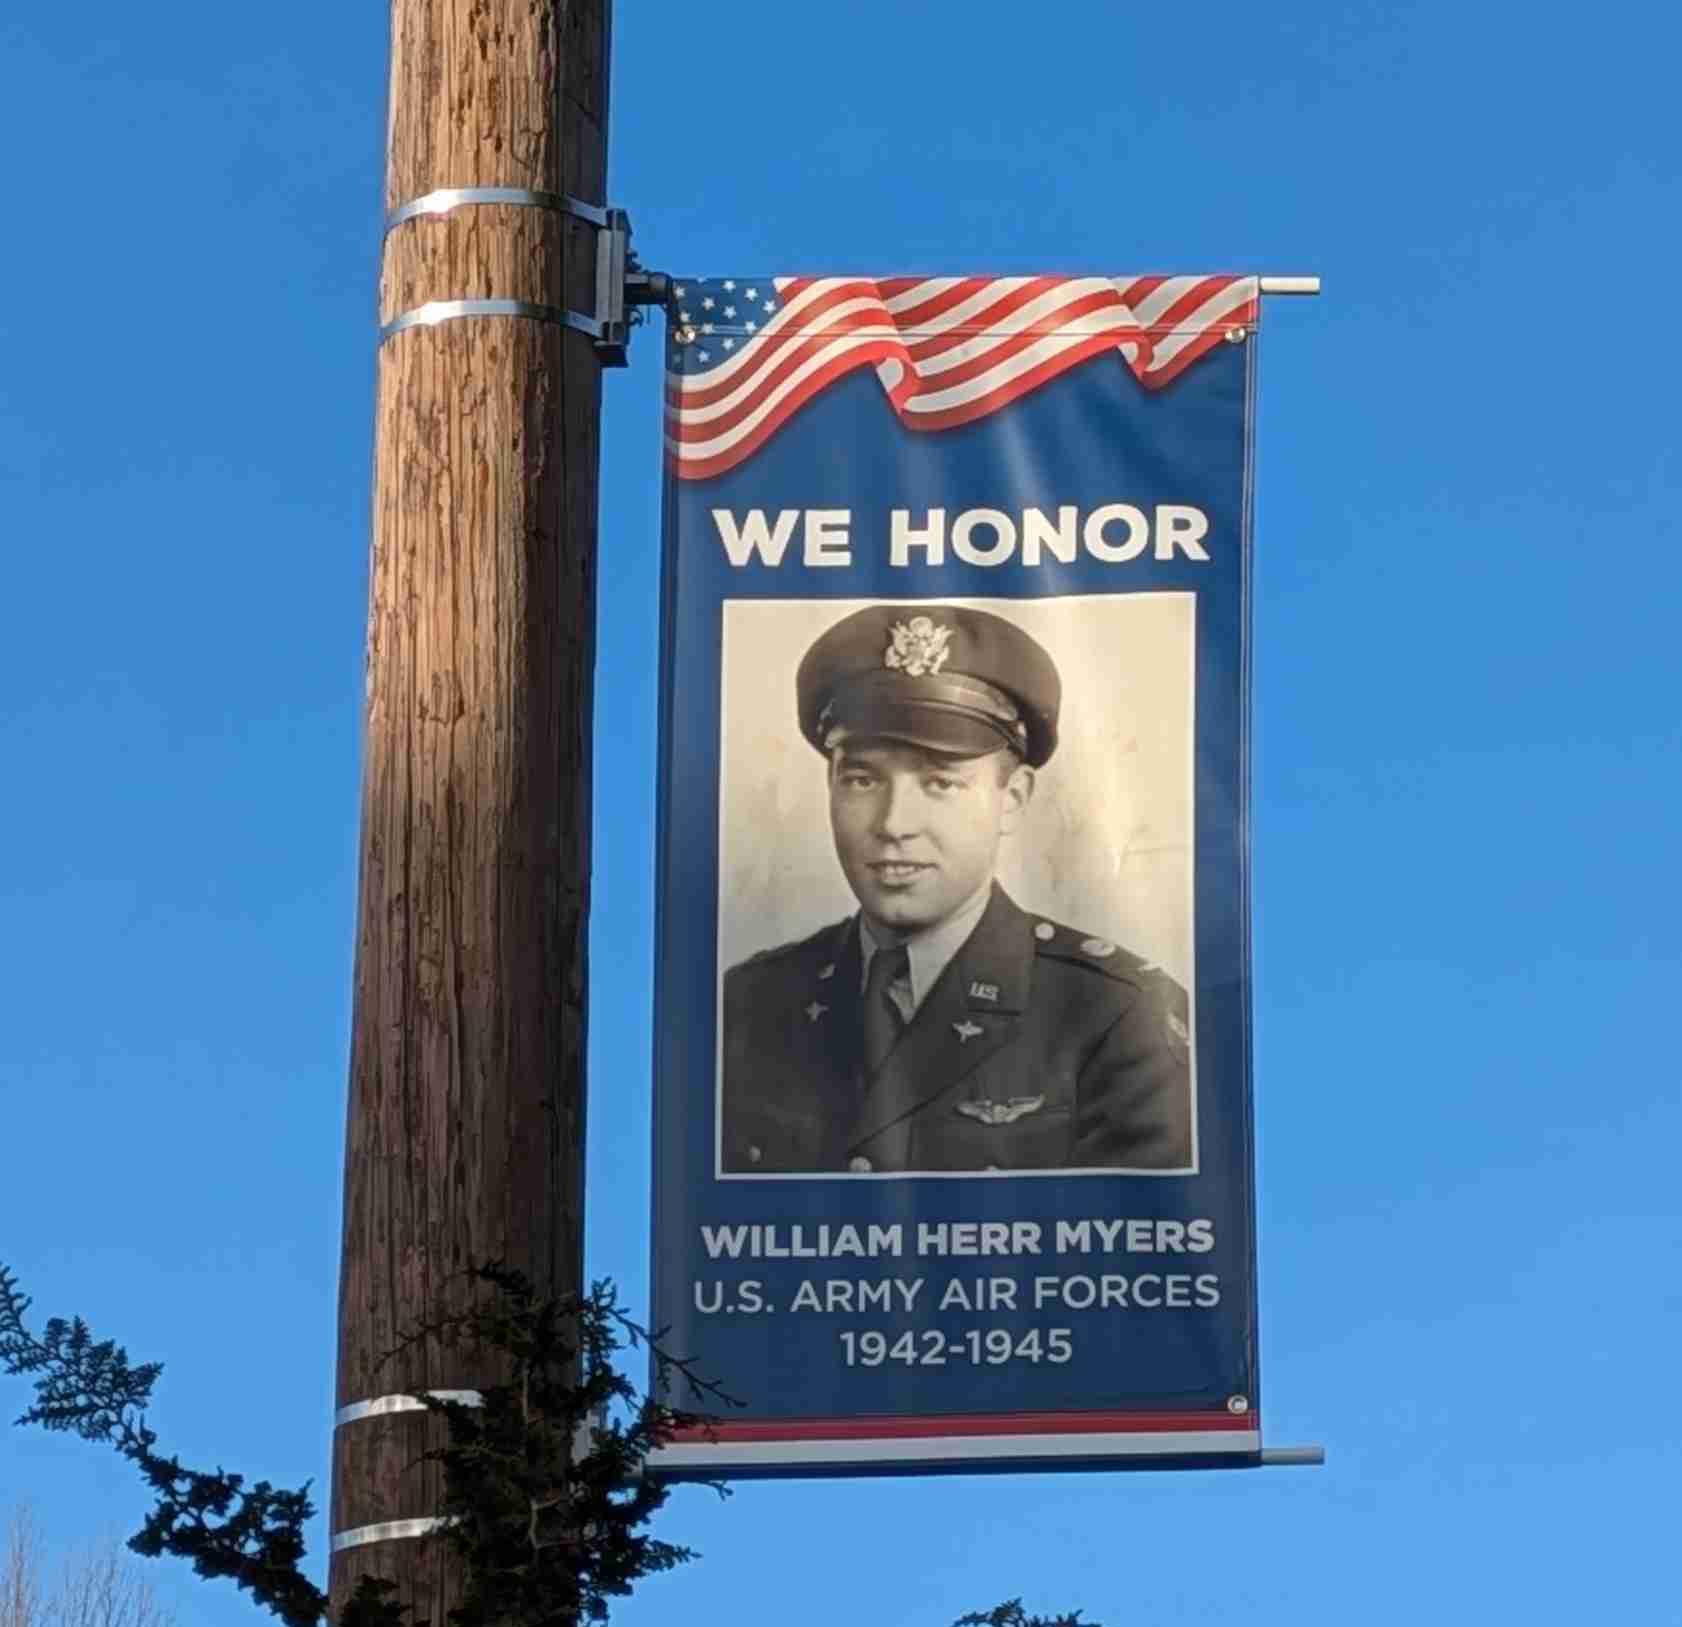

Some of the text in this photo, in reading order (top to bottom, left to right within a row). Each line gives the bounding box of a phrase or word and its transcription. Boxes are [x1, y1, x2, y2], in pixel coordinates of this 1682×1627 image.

[712, 502, 1210, 567] WE HONOR
[701, 1219, 1215, 1258] WILLIAM HERR MYERS
[693, 1274, 1221, 1314] U.S. ARMY AIR FORCES
[839, 1328, 1073, 1366] 1942-1945
